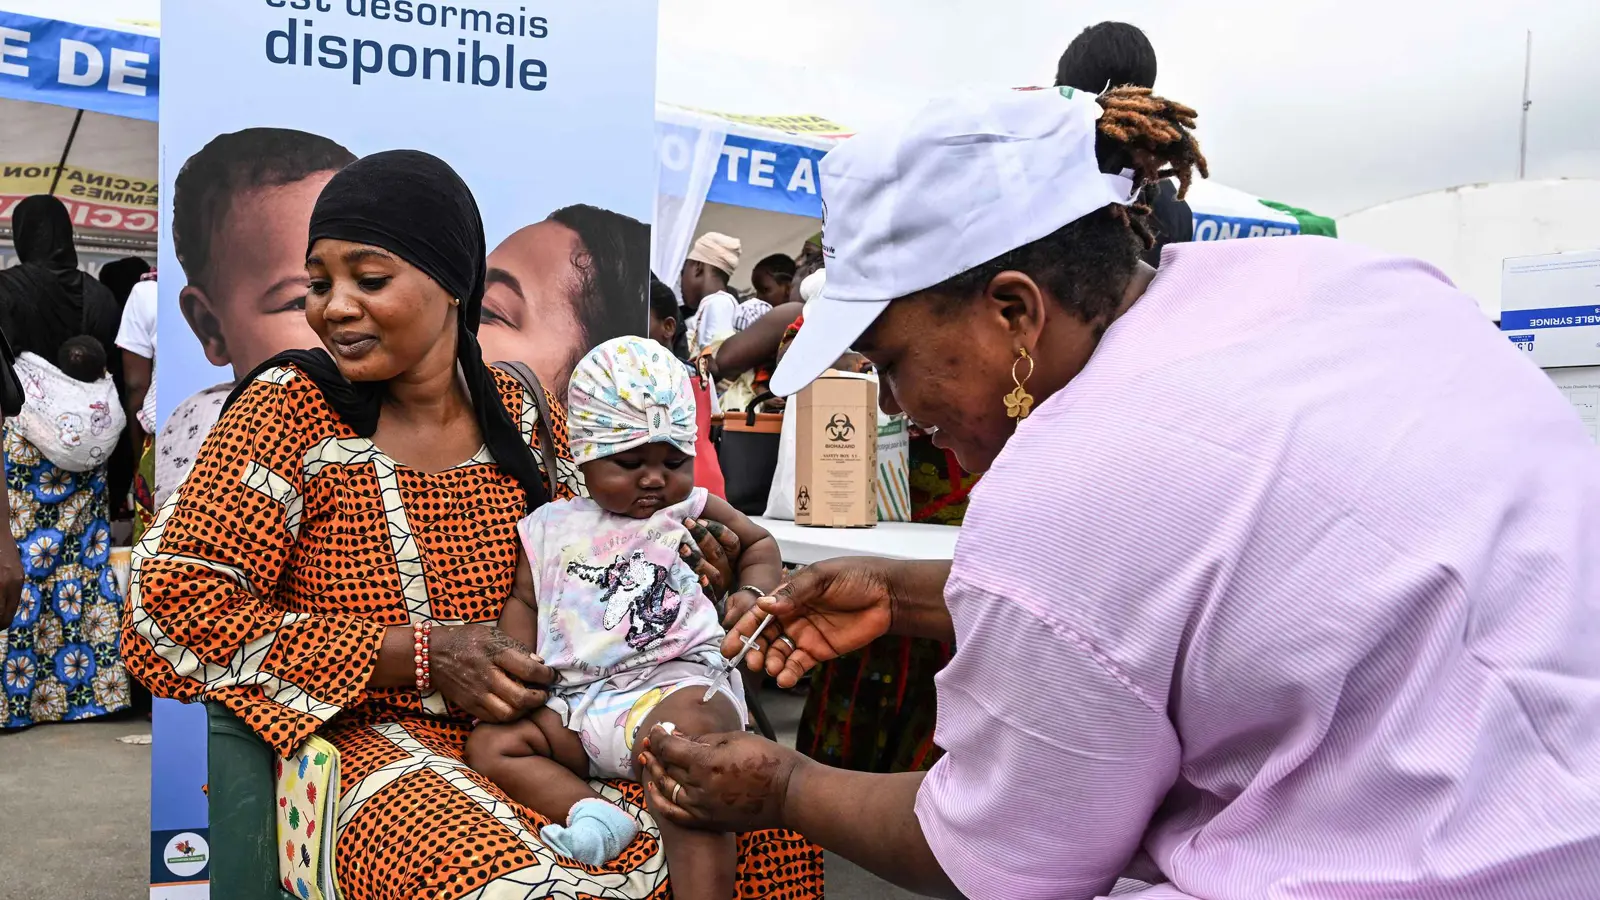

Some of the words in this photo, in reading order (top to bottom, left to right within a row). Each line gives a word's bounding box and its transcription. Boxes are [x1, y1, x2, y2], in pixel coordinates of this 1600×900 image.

[57, 38, 150, 97] DE
[265, 18, 548, 92] disponible
[1529, 316, 1573, 327] SYRINGE
[1514, 342, 1534, 352] 0.5
